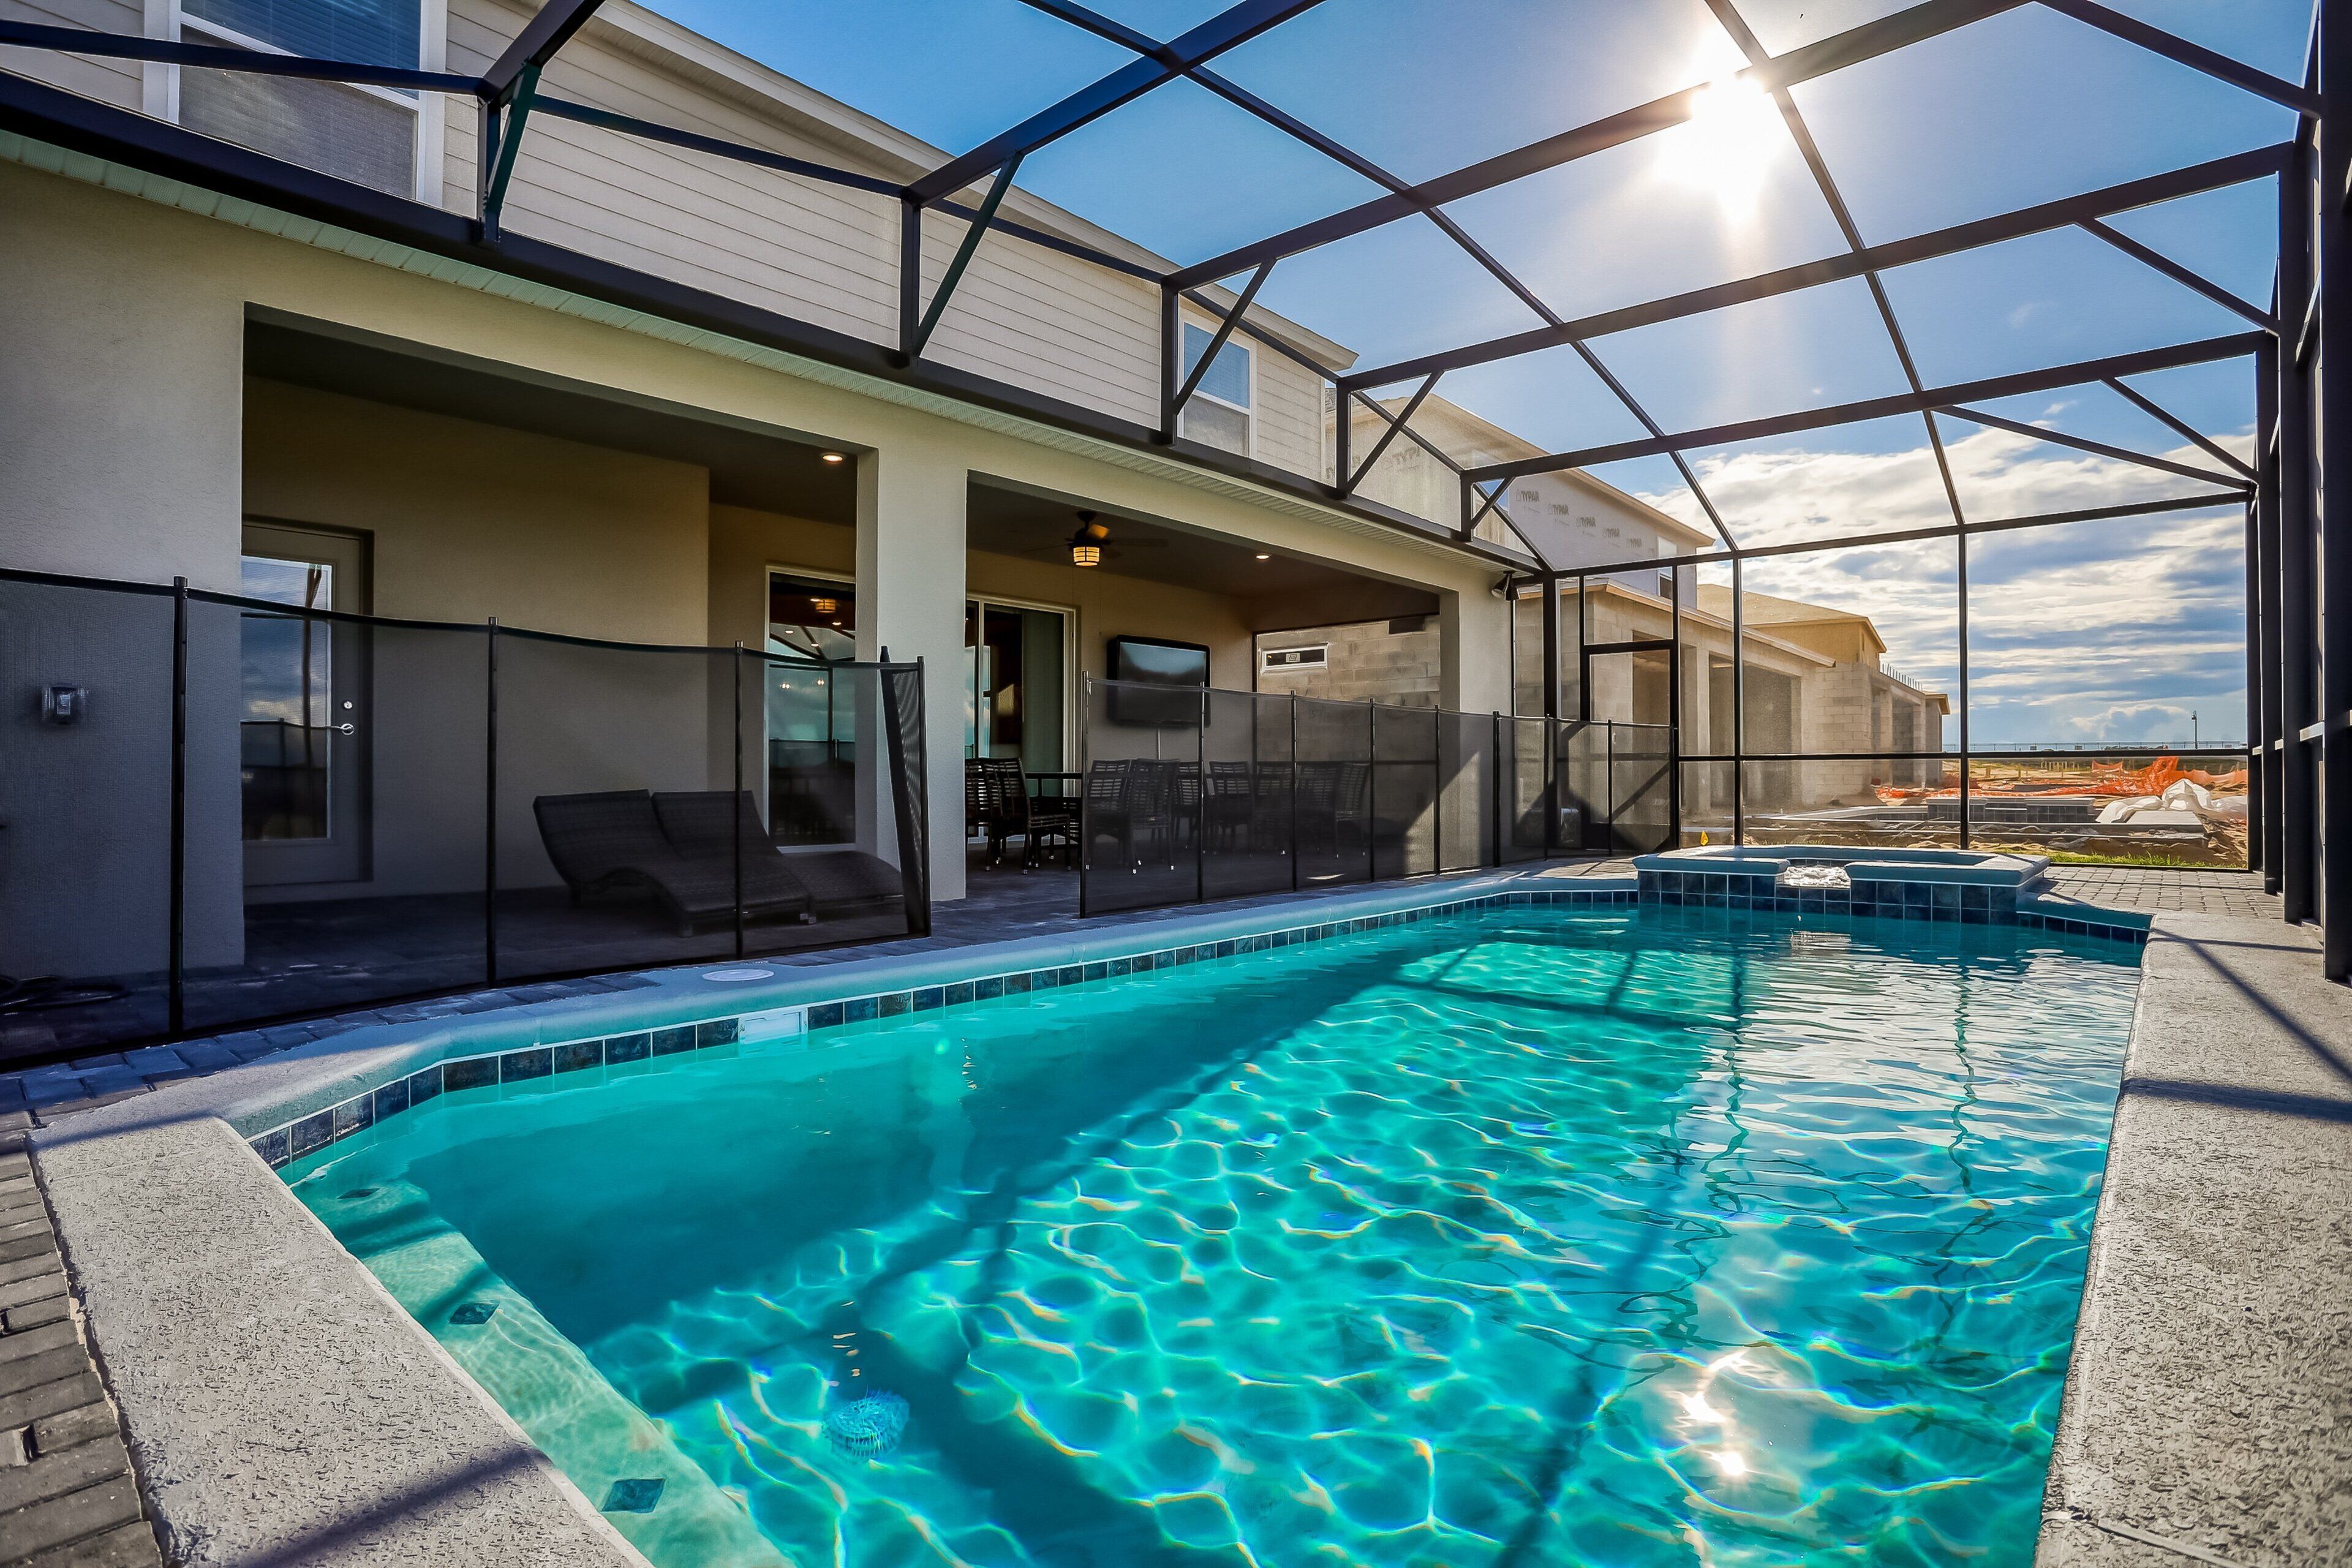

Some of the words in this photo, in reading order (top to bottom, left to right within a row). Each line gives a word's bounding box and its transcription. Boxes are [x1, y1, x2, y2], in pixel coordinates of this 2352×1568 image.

[1521, 491, 1539, 502] TYPAR
[1552, 504, 1569, 515] TYPAR
[1580, 517, 1596, 527] TYPAR
